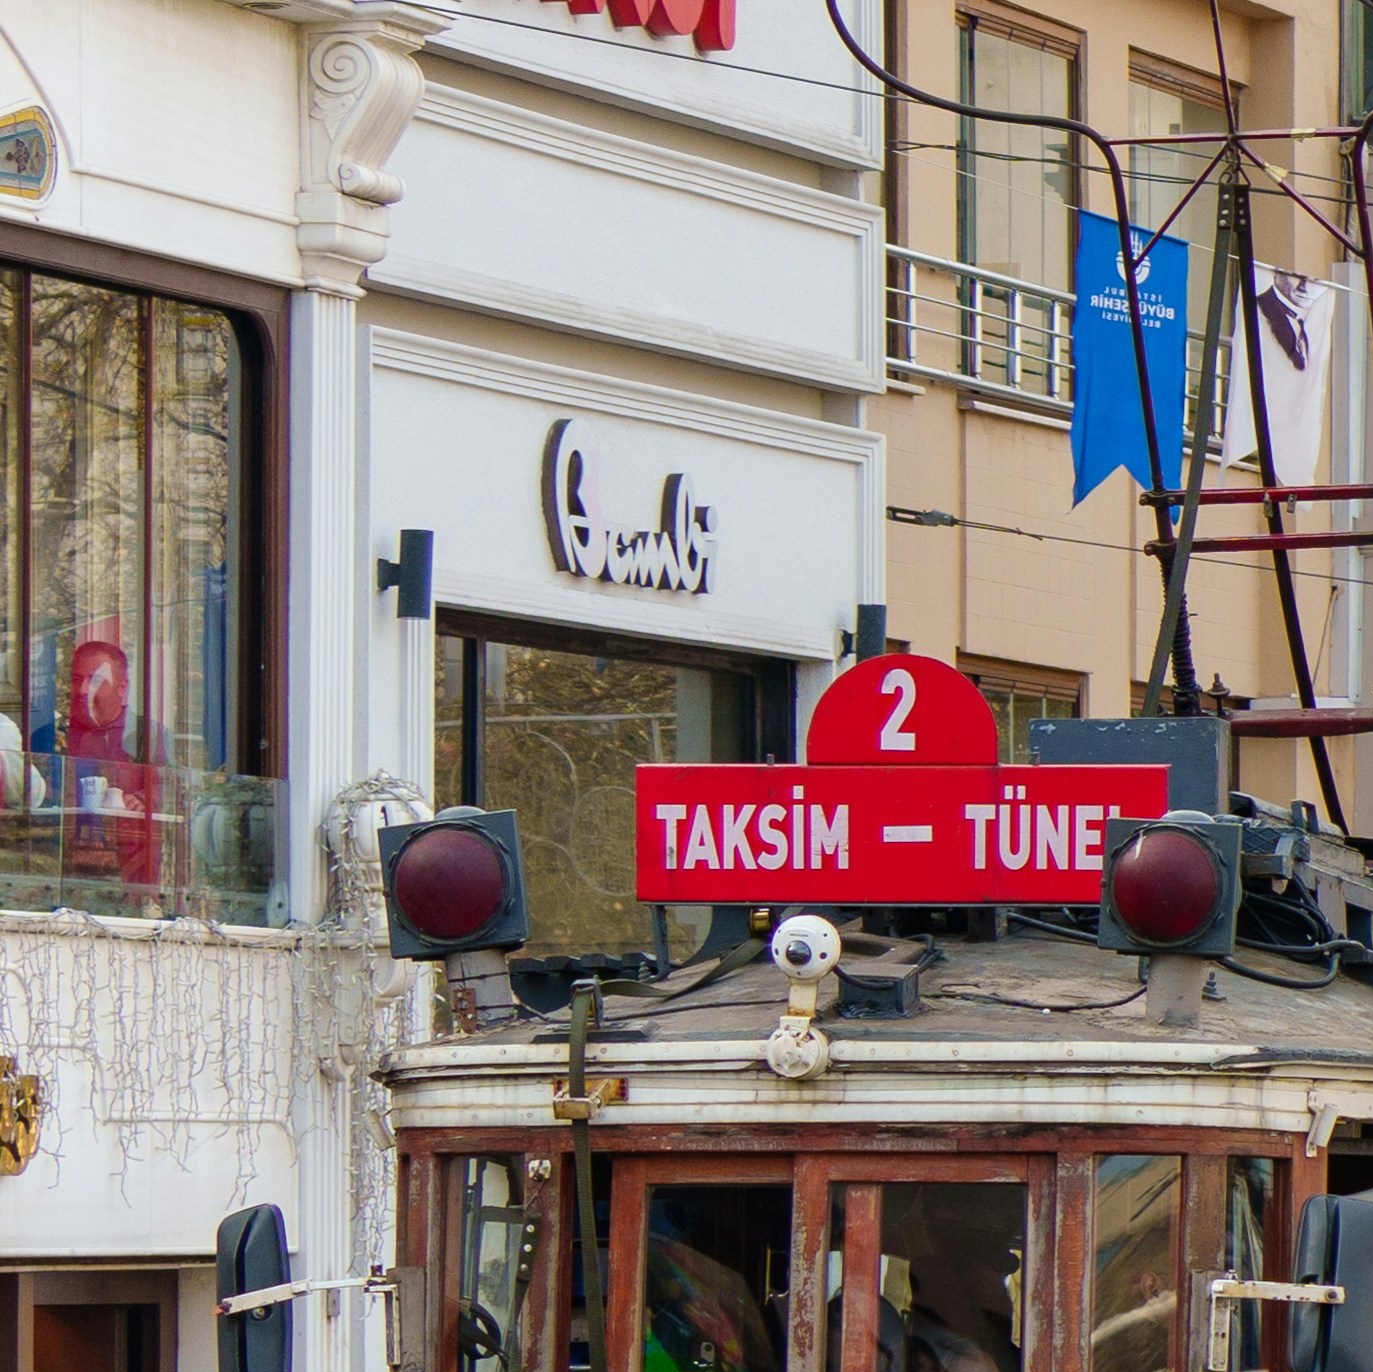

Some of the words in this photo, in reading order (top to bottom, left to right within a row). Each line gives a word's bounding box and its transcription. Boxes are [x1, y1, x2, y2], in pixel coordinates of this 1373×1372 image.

[880, 668, 916, 751] 2
[656, 785, 850, 871] TAKSİM
[965, 785, 1120, 871] TÜNE
